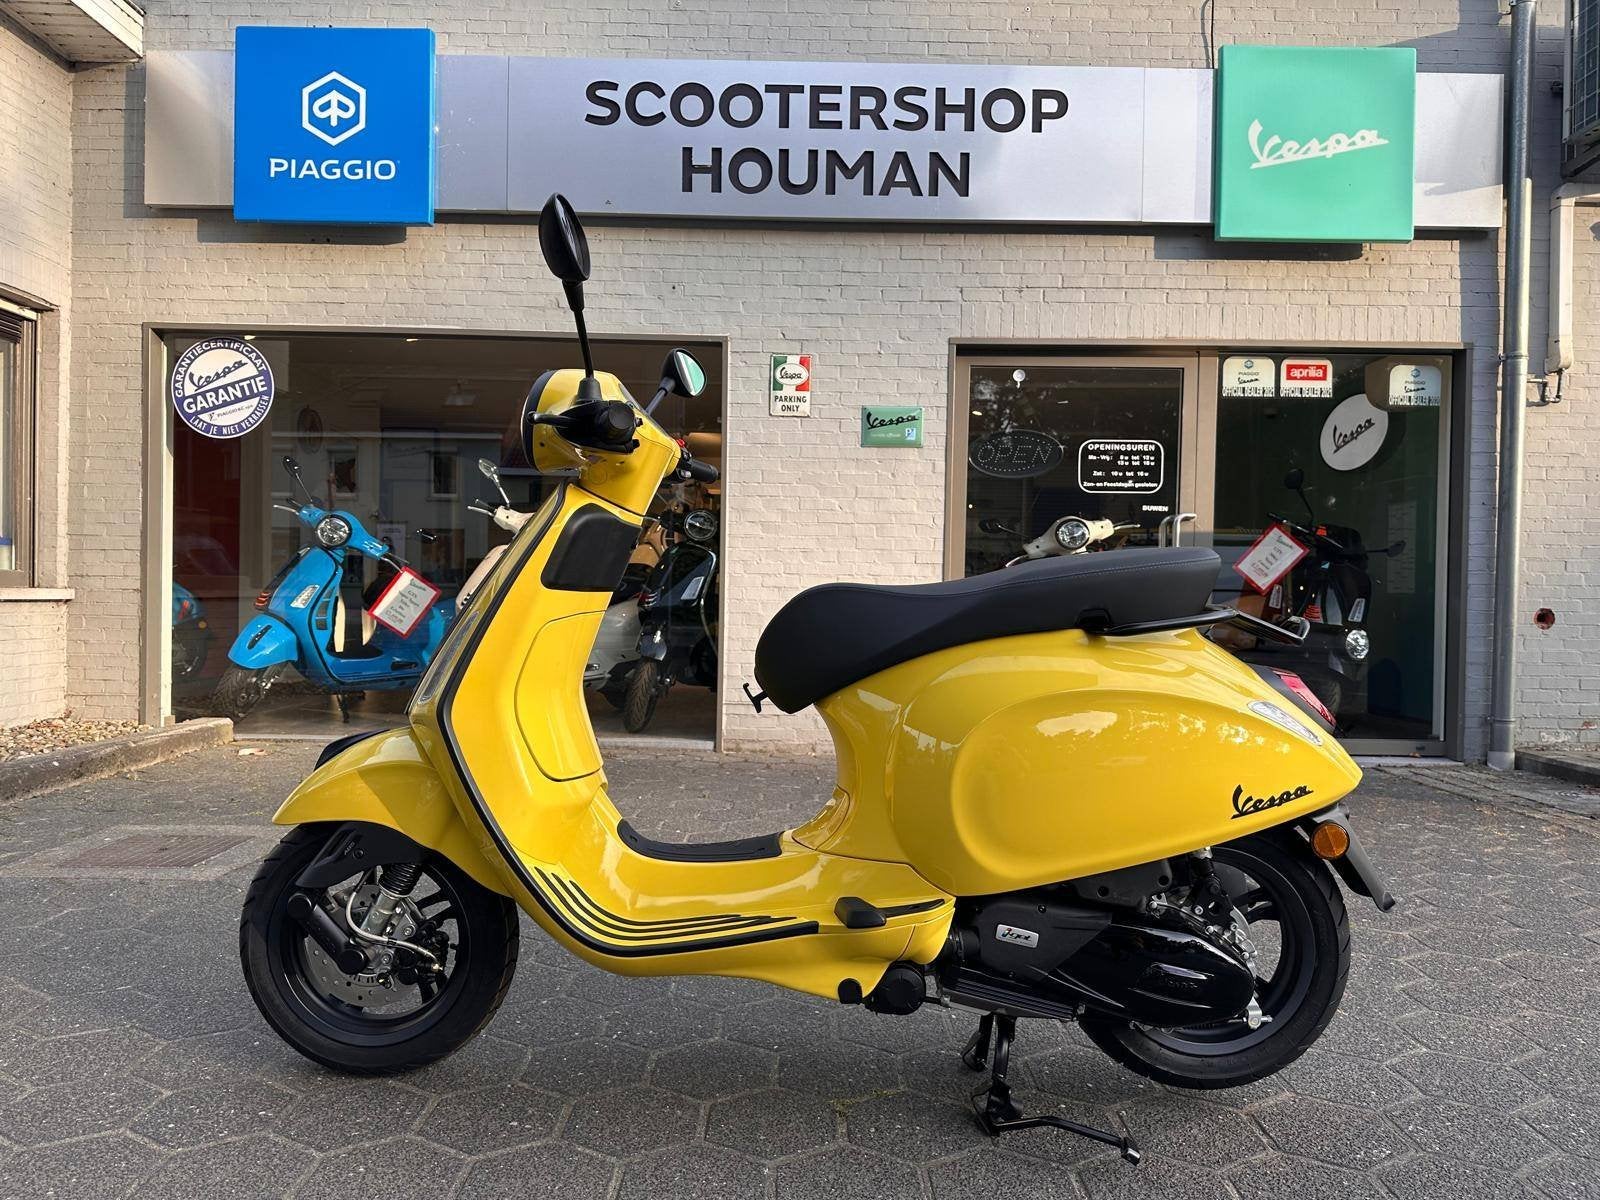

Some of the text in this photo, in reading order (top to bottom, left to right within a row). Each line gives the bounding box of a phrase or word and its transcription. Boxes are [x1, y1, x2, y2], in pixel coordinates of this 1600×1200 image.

[584, 80, 1069, 133] SCOOTERSHOP
[1248, 118, 1389, 169] Vespa
[269, 157, 396, 180] PIAGGIO
[682, 146, 970, 197] HOUMAN
[174, 339, 267, 398] GARANTIECERTIFICAAT
[188, 360, 248, 392] Vespa
[780, 366, 802, 379] Vespa
[1290, 365, 1324, 379] aprilia
[183, 376, 268, 413] GARANTIE
[774, 395, 807, 403] PARKING
[1222, 387, 1243, 397] OFFICIAL
[1280, 387, 1301, 397] OFFICIAL
[190, 395, 270, 435] LAAT JE NIET VERRASSEN
[781, 404, 800, 412] ONLY
[866, 411, 920, 430] Vespa
[1088, 443, 1155, 451] OPENINGSUREN
[1333, 418, 1376, 454] Vespa
[978, 445, 1053, 464] OPEN
[1231, 784, 1314, 819] Vespa
